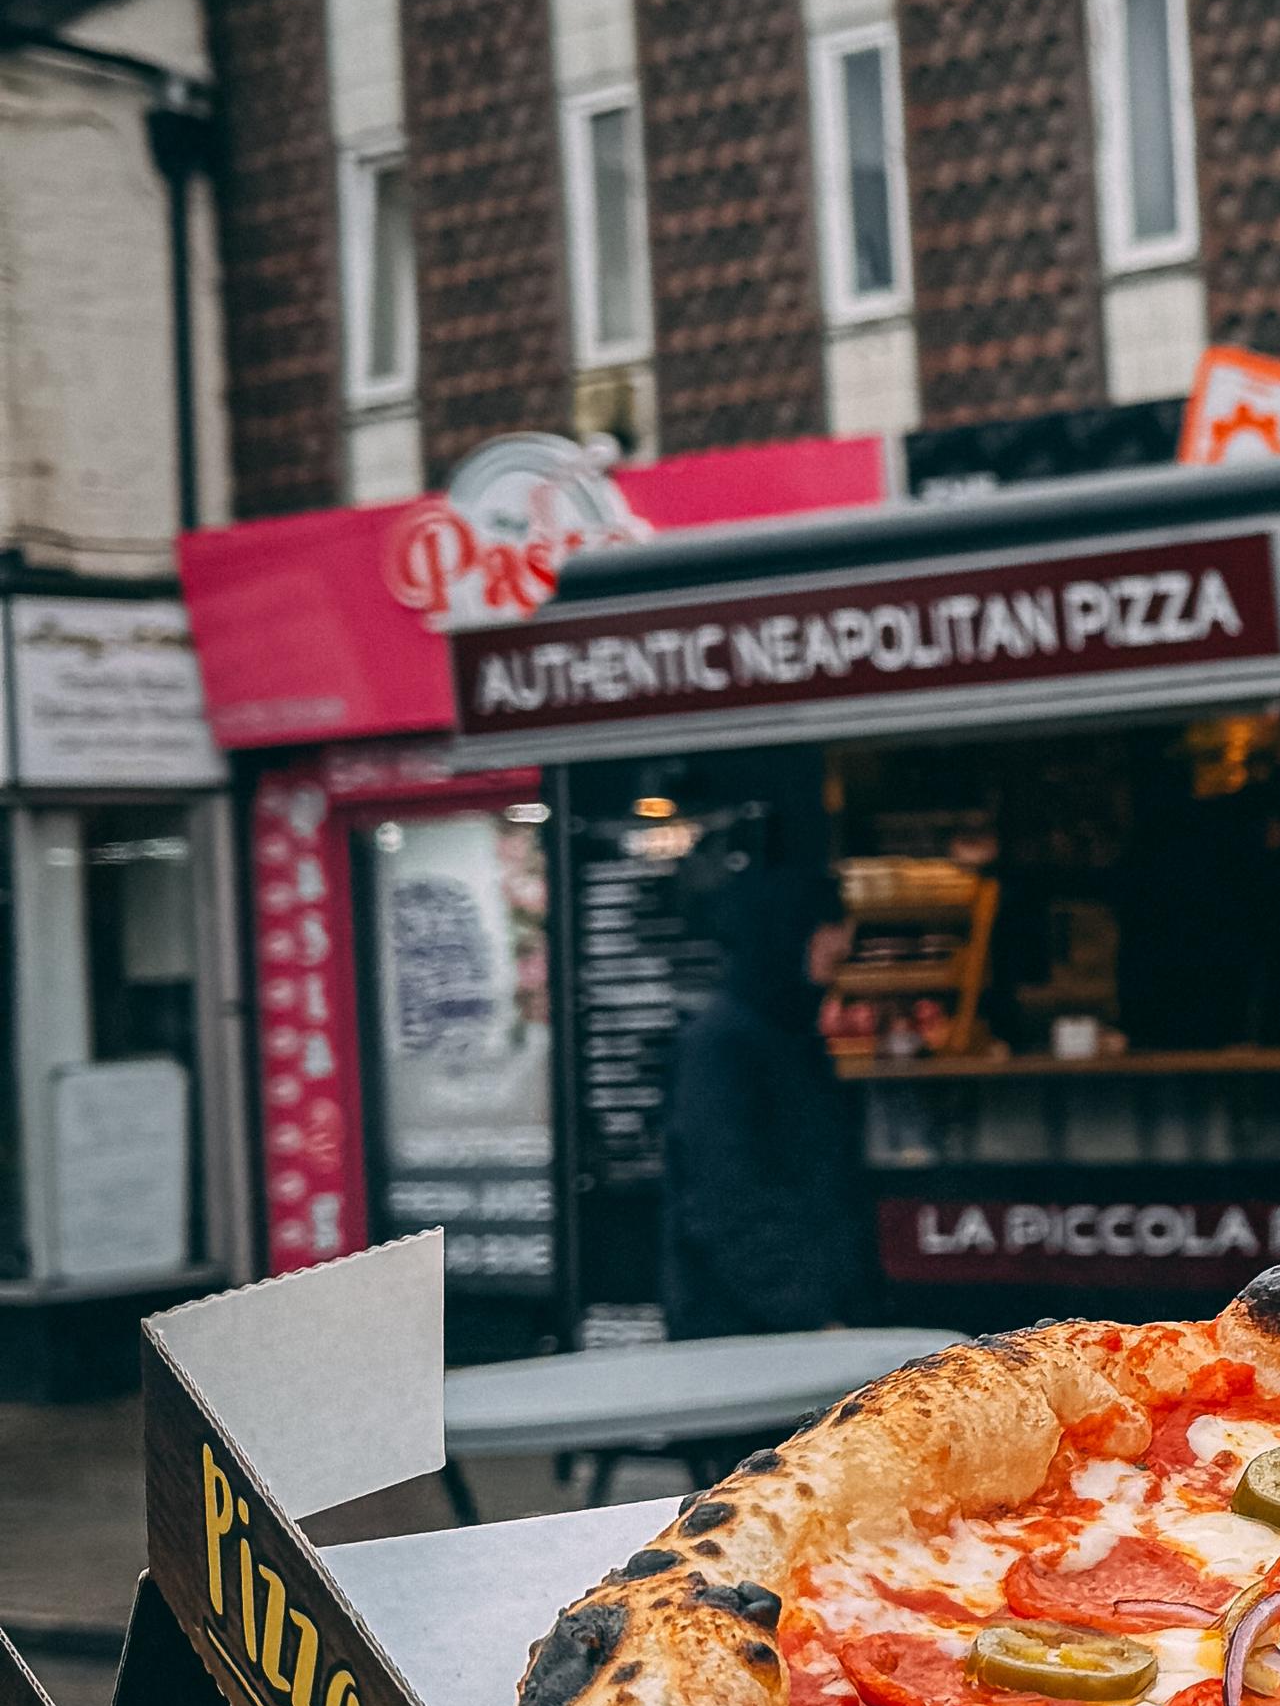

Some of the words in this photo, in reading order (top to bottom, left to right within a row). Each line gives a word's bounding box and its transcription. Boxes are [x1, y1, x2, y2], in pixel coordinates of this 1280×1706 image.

[476, 623, 731, 715] AUTHENTIC
[733, 588, 1056, 686] NEAPOLITAN
[1064, 568, 1244, 651] PIZZA
[917, 1205, 995, 1257] LA
[1004, 1204, 1259, 1259] PICCOLA
